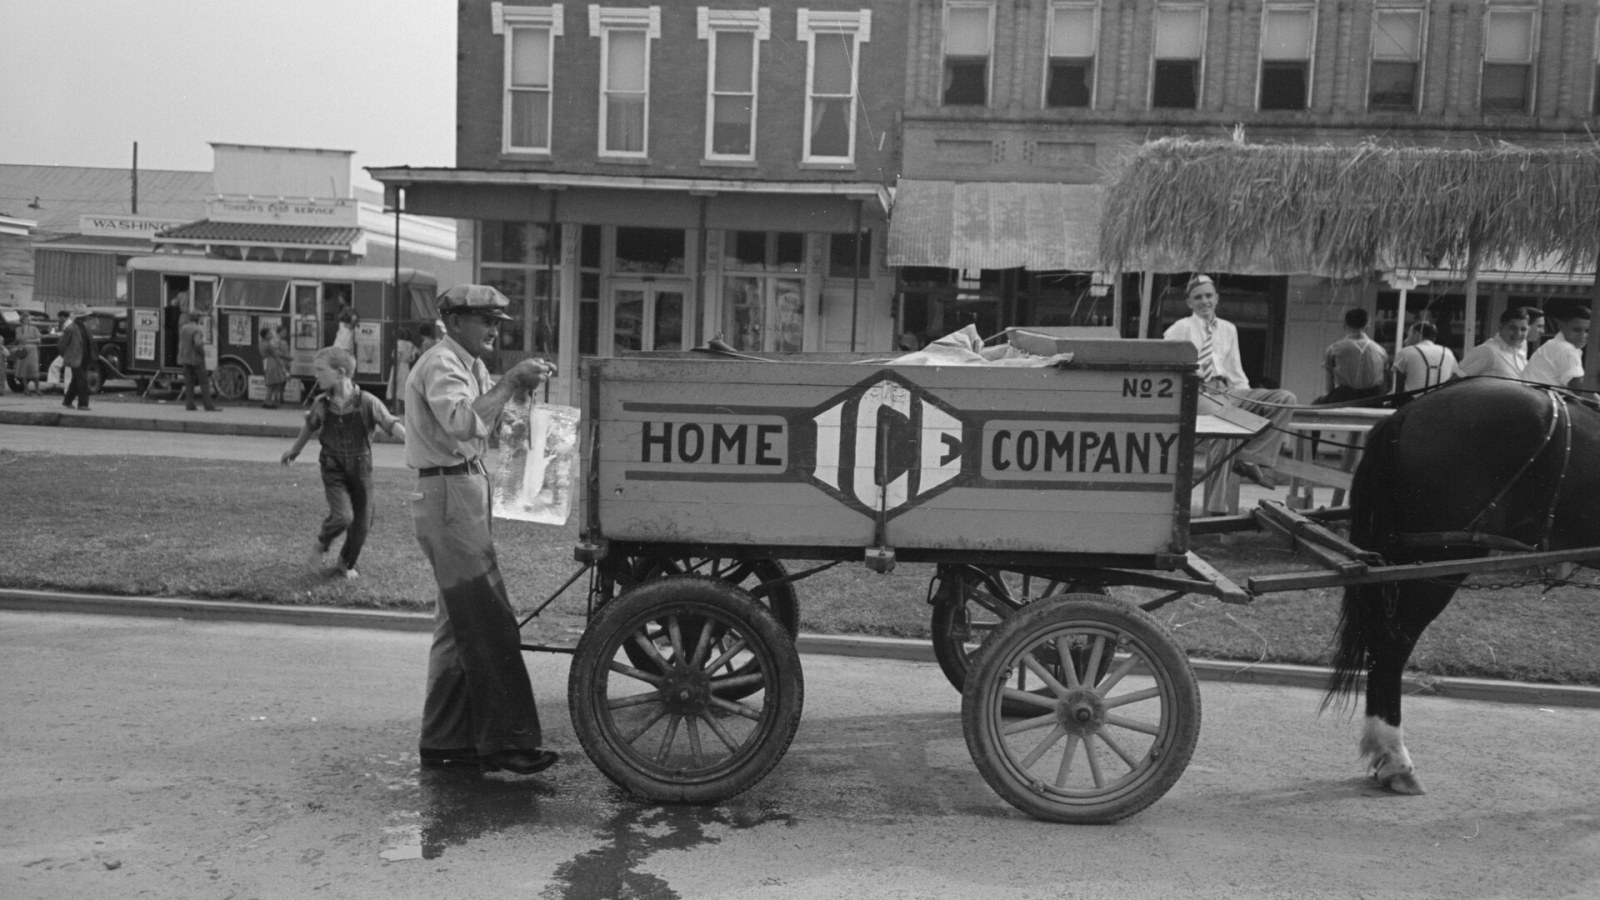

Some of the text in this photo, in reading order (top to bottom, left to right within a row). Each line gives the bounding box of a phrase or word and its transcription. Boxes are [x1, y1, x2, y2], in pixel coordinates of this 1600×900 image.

[1157, 378, 1174, 398] 2
[641, 379, 1179, 512] HOME ICE COMPANY
